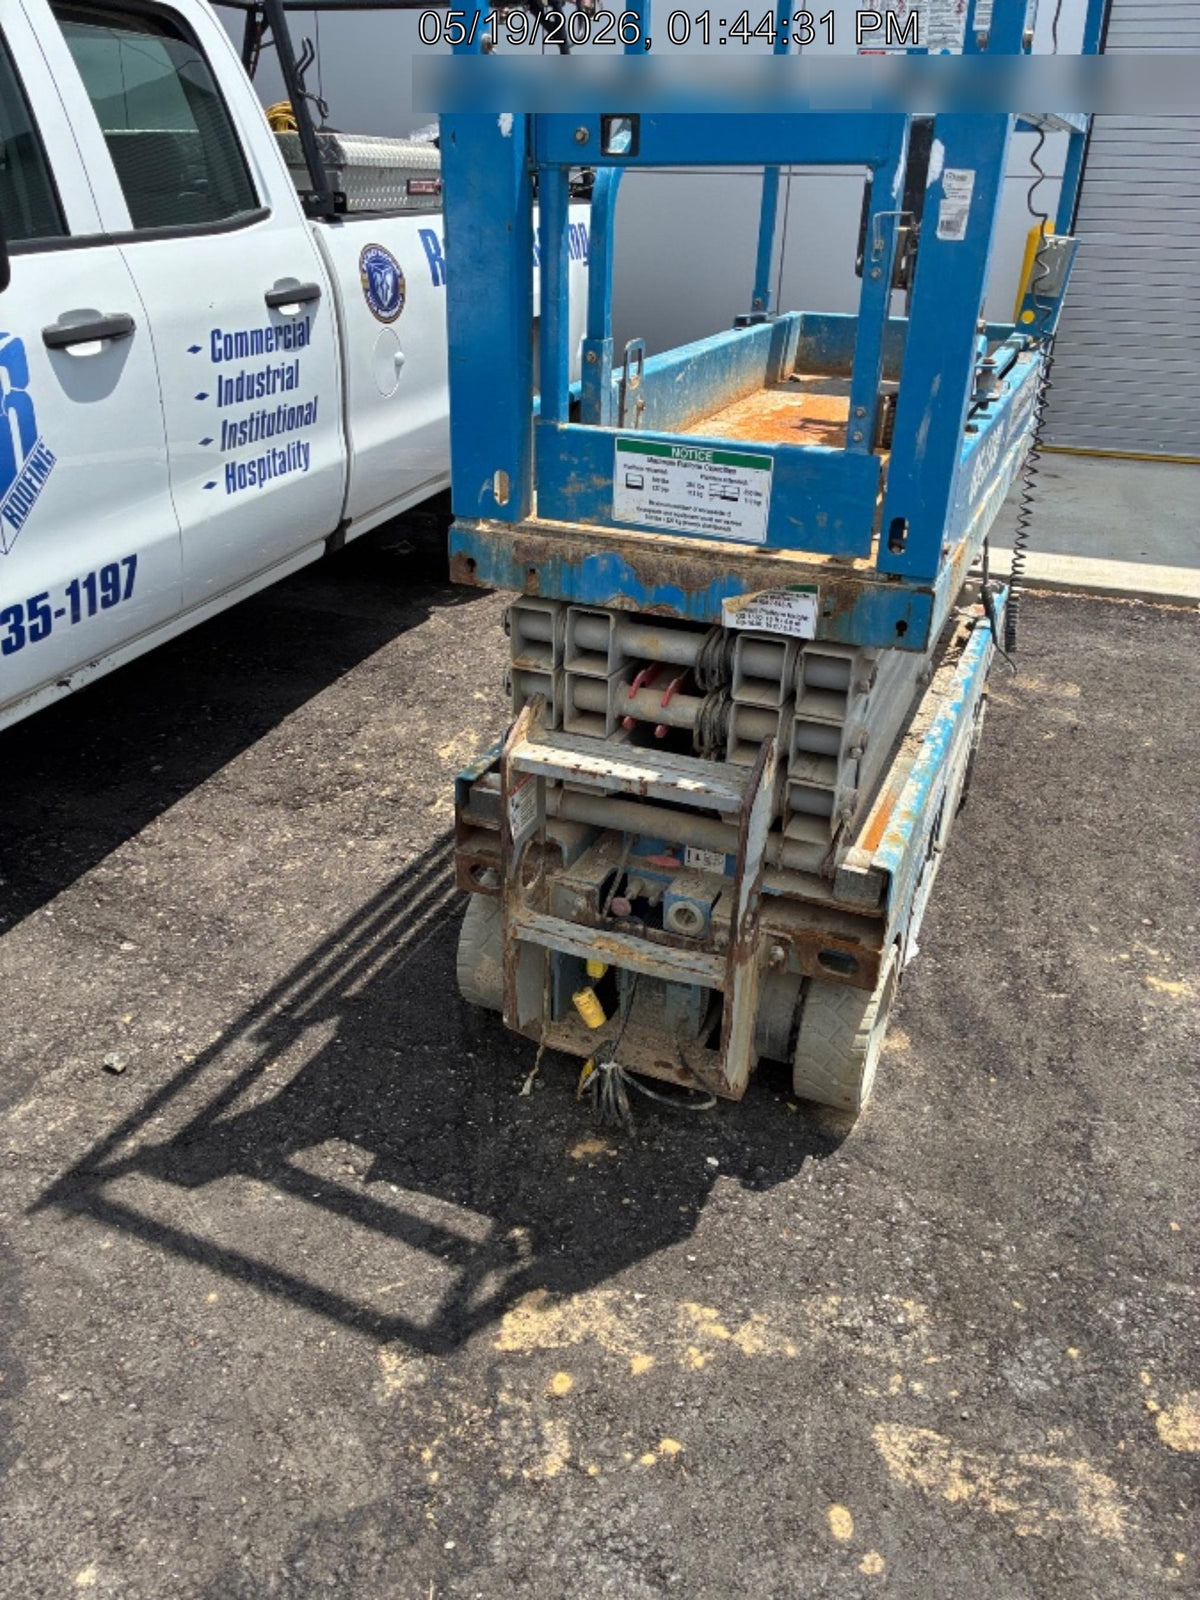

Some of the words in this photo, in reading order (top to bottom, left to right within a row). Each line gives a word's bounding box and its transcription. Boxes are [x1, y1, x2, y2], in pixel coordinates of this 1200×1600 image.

[210, 316, 310, 363] Commercial
[217, 359, 299, 407] Industrial
[220, 395, 318, 452] Institutional
[225, 440, 310, 494] Hospitality
[671, 447, 713, 461] NOTICE
[1, 443, 55, 530] ROOFING
[0, 552, 137, 656] 35-1197
